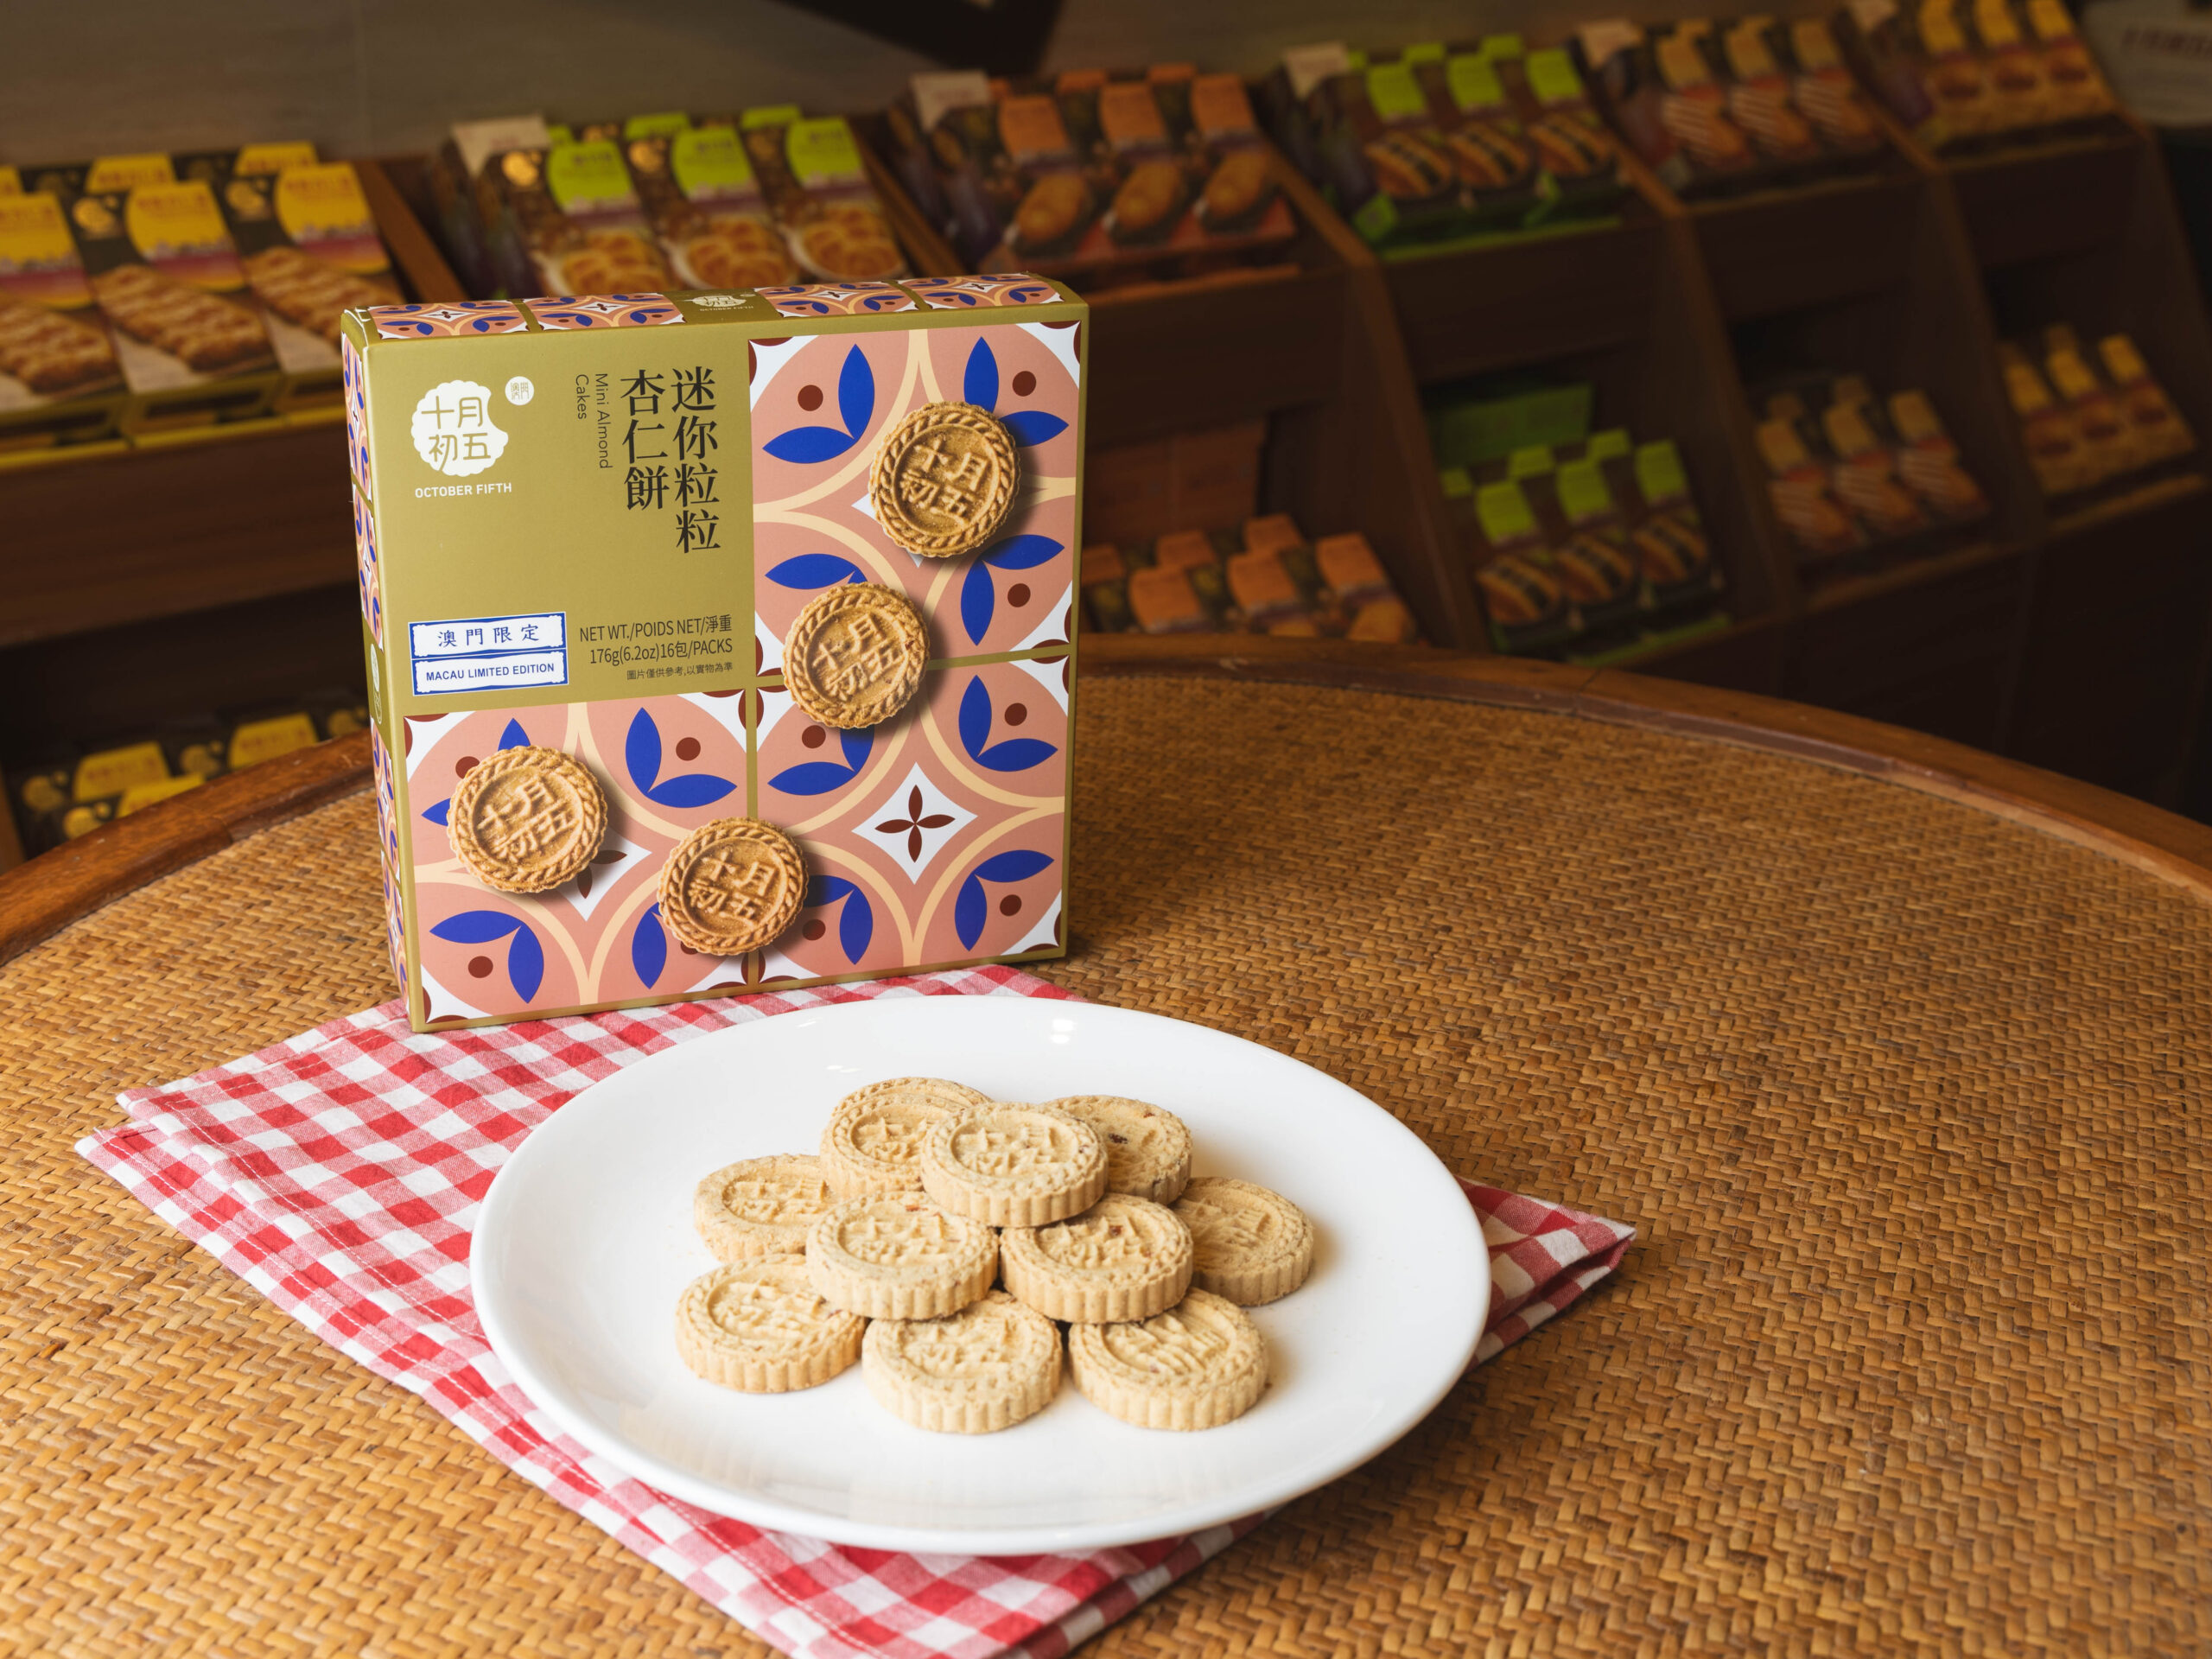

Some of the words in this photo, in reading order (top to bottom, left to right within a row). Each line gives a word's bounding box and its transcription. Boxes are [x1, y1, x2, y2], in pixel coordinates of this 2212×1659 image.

[575, 374, 590, 420] Cakes
[595, 373, 609, 405] Mini
[421, 396, 483, 429] 十月
[429, 432, 491, 471] 初五
[597, 410, 613, 468] Almond
[620, 369, 670, 511] 杏仁餅
[671, 365, 721, 554] 迷你粒粒
[415, 485, 473, 498] OCTOBER
[476, 482, 512, 495] FIFTH
[437, 624, 539, 648] 澳門限定
[580, 626, 605, 642] NET
[607, 620, 674, 642] WT./POIDS
[426, 670, 464, 681] MACAU
[467, 666, 510, 678] LIMITED
[512, 663, 555, 675] EDITION
